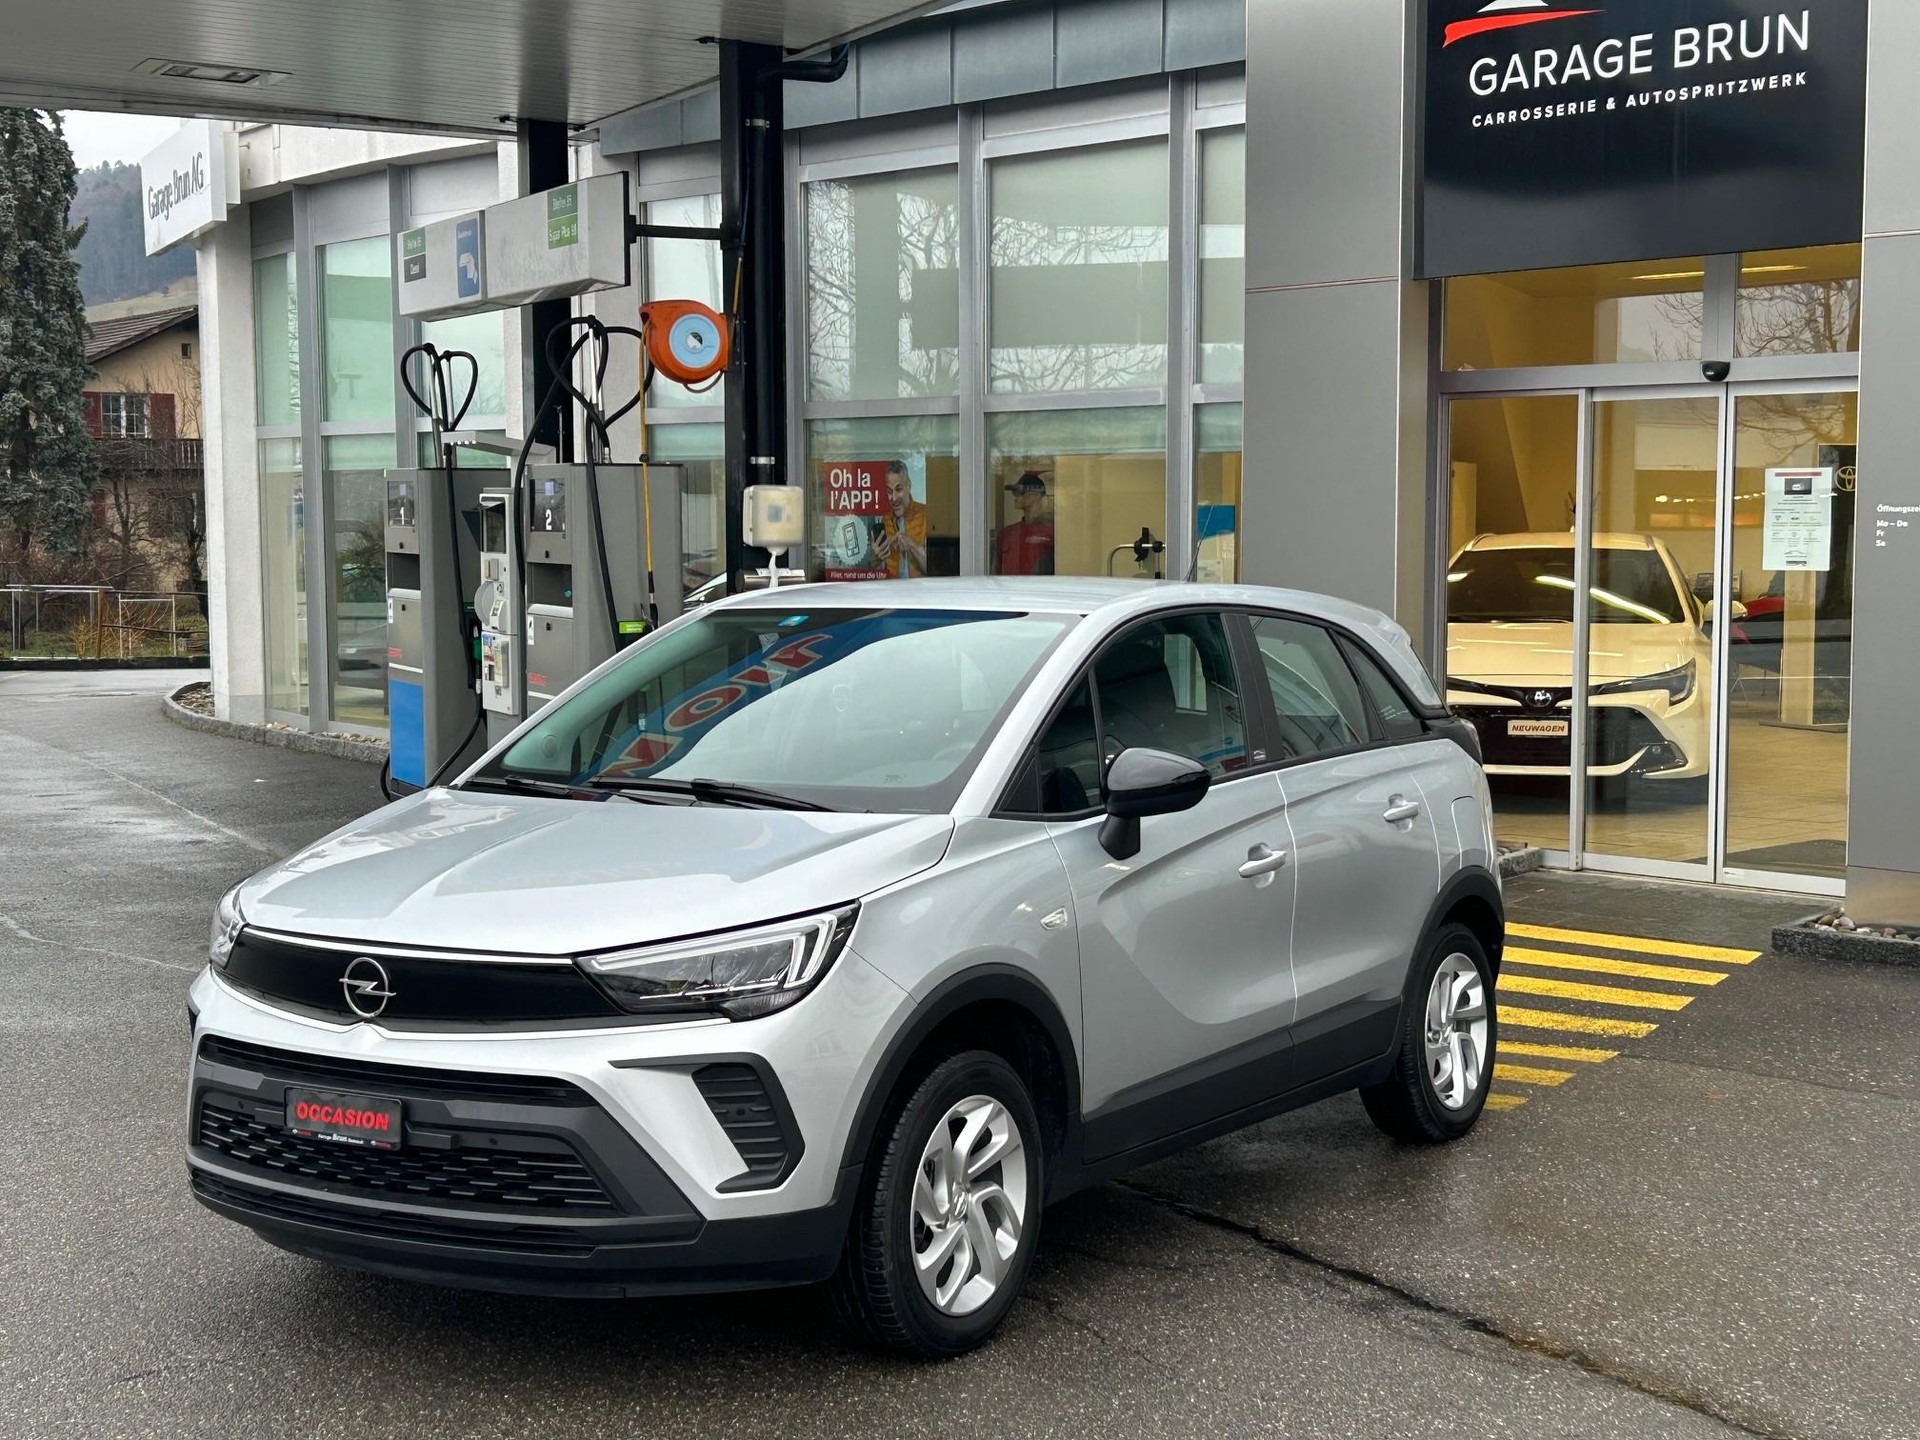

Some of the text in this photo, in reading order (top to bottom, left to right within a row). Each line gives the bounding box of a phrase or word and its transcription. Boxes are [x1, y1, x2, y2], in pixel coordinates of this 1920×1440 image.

[1469, 10, 1809, 96] GARAGE BRUN
[1472, 72, 1807, 128] CARROSSERIE & AUTOSPRITZWERK
[148, 151, 204, 221] Garage Brun AG
[830, 468, 871, 488] Oh la
[545, 509, 552, 531] 2
[1877, 519, 1889, 527] Mo
[1875, 539, 1886, 547] Sa
[1876, 529, 1885, 537] Fr
[1511, 724, 1565, 732] NEUWAGEN
[296, 1101, 391, 1131] OCCASION
